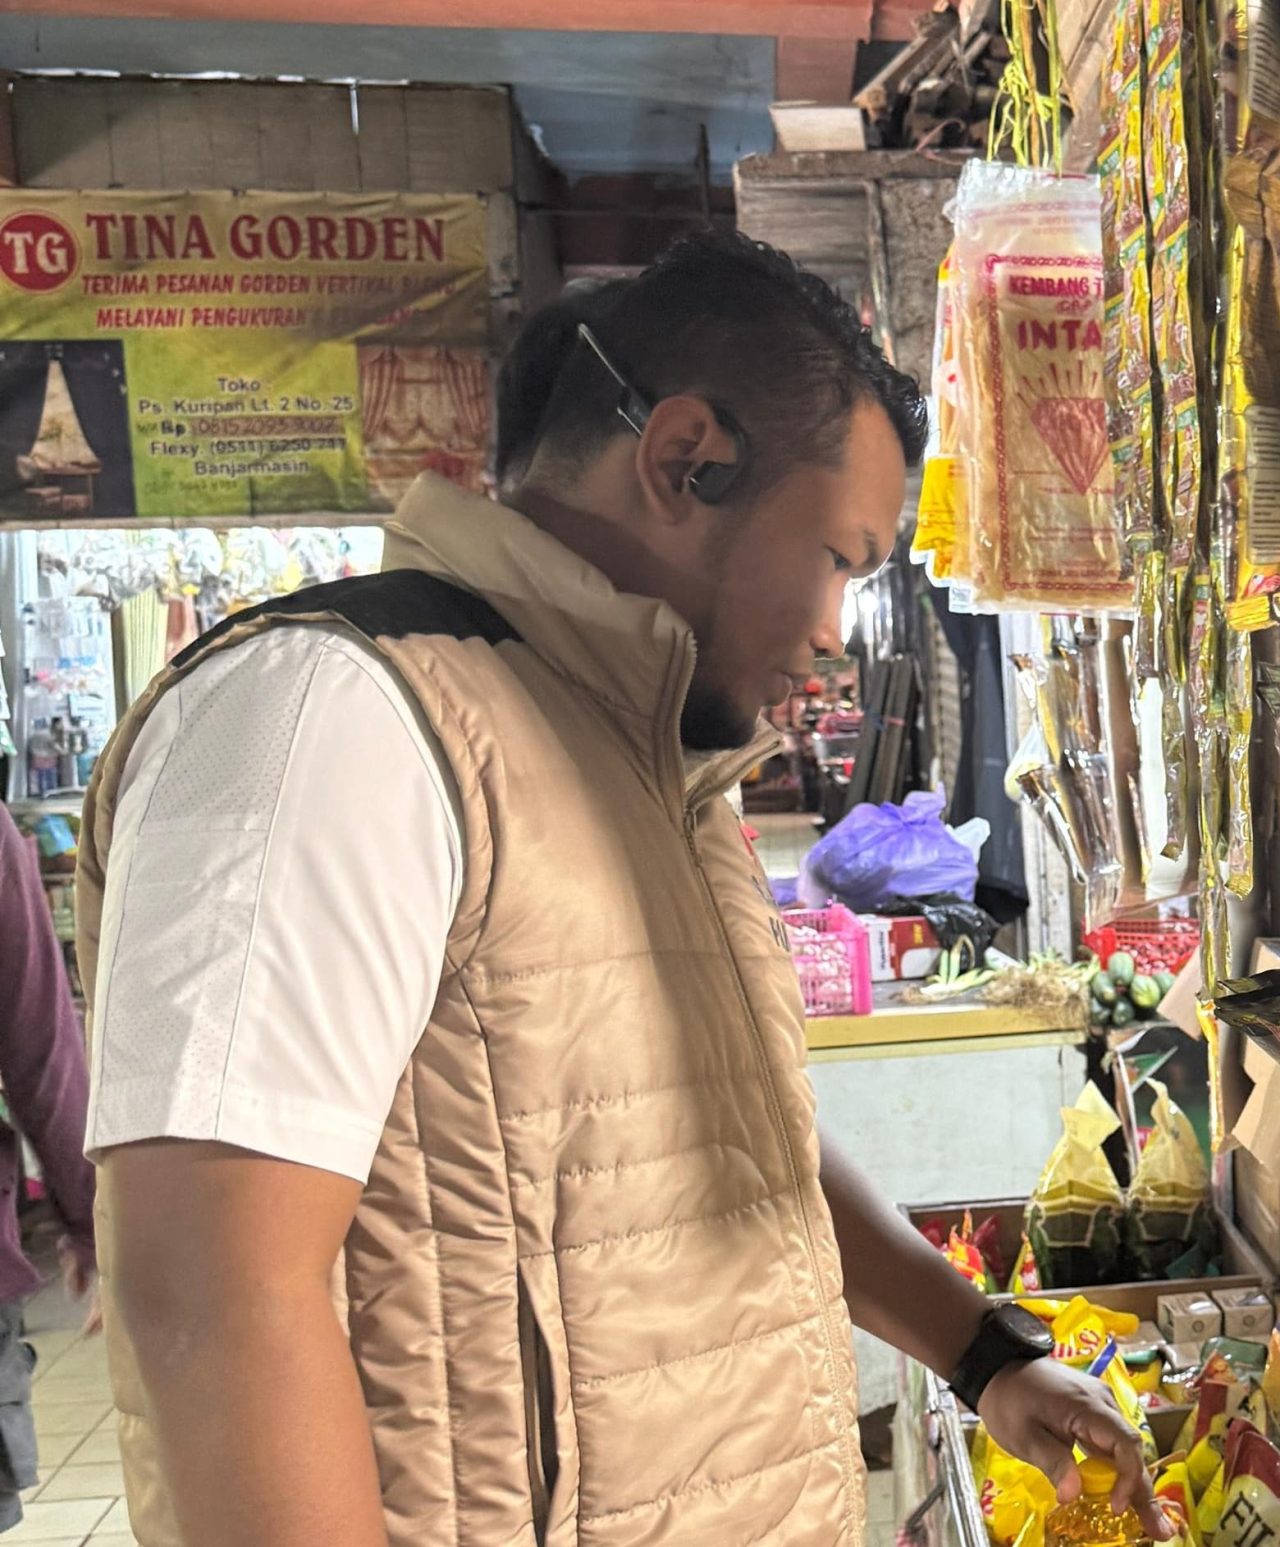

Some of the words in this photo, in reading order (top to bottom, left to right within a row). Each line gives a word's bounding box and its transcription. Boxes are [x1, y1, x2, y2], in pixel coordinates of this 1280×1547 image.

[86, 213, 216, 260] TINA
[229, 214, 446, 262] GORDEN
[4, 231, 68, 274] TG
[82, 274, 150, 295] TERIMA
[156, 273, 234, 294] PESANAN
[240, 273, 310, 295] GORDEN
[1009, 275, 1089, 297] KEMBANG
[96, 307, 184, 329] MELAYANI
[192, 306, 307, 328] PENGUKURAN
[1017, 318, 1102, 352] INTA
[217, 377, 261, 393] Toko
[174, 399, 245, 416] Kuripan
[280, 397, 289, 411] 2
[195, 460, 310, 478] Banjarmasin
